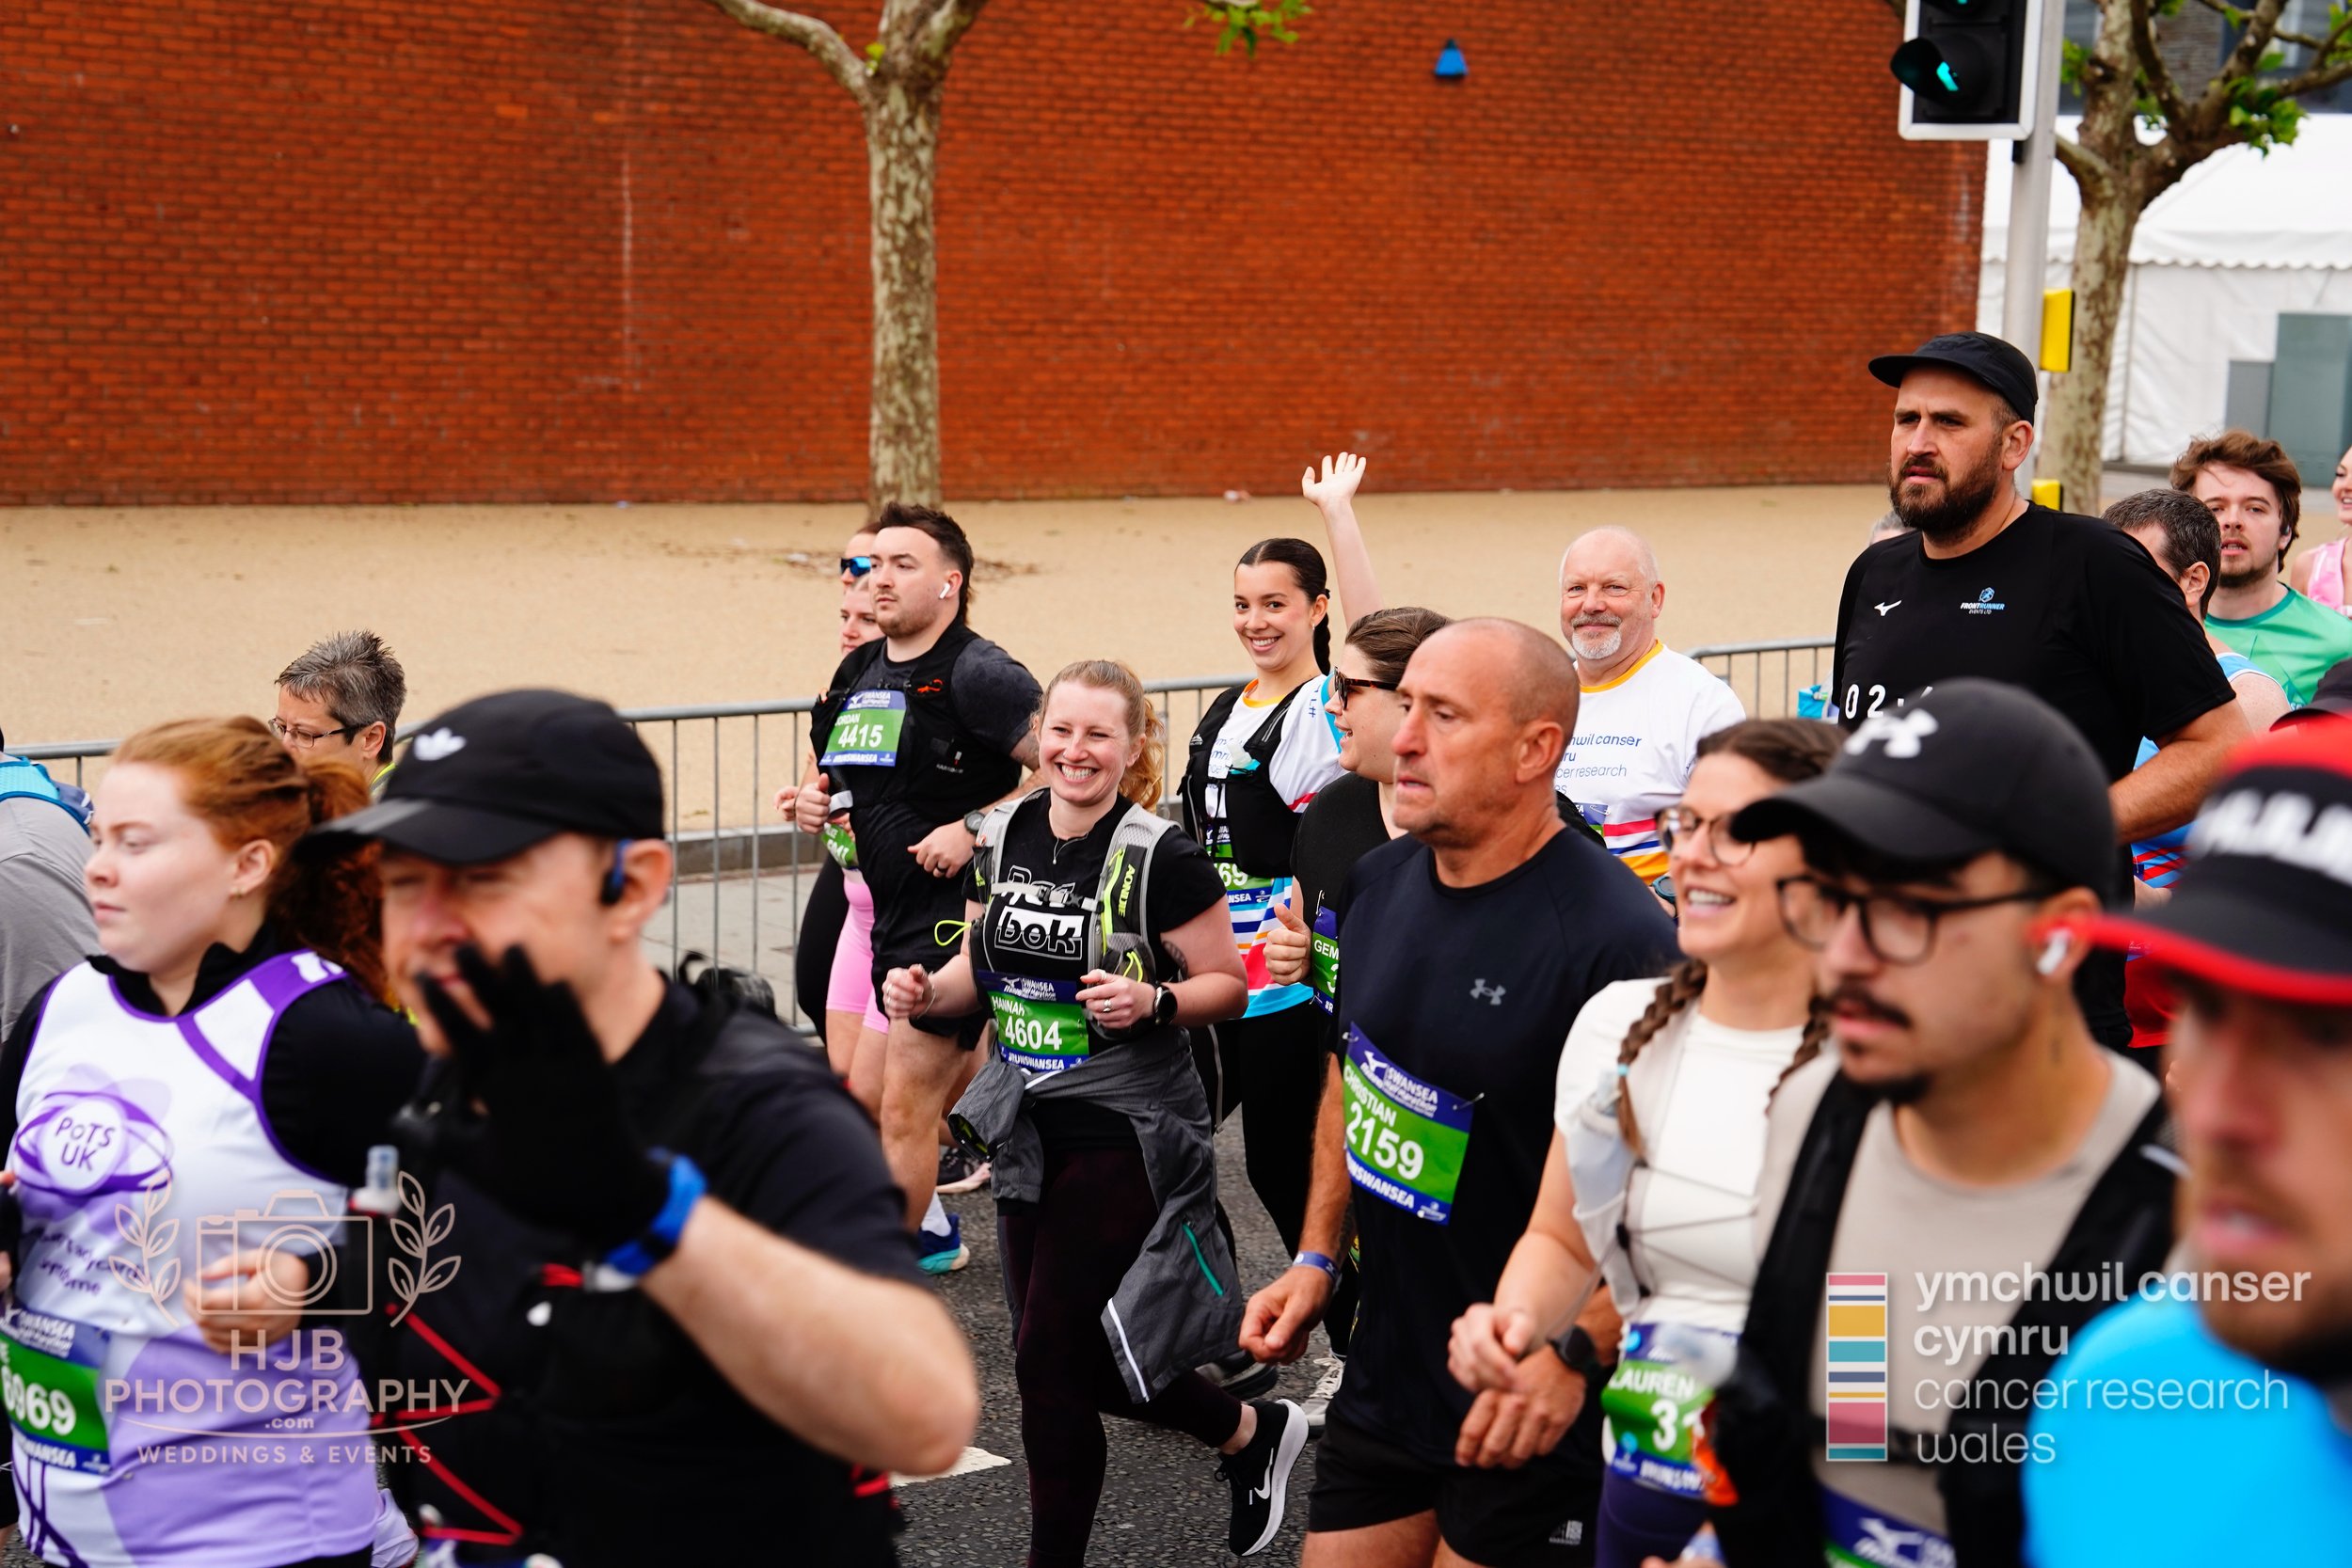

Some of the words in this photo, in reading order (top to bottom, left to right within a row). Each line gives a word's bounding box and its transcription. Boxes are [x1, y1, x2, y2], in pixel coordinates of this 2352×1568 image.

[837, 723, 884, 749] 4415
[1596, 735, 1642, 747] canser
[1575, 764, 1628, 778] research
[1313, 939, 1340, 960] GEM
[991, 995, 1025, 1017] HANNAH
[1005, 1015, 1063, 1051] 4604
[1343, 1065, 1397, 1128] CHRISTIAN
[1387, 1066, 1438, 1105] SWANSEA
[1345, 1100, 1424, 1180] 2159
[60, 1142, 96, 1172] UK
[1608, 1368, 1697, 1401] LAUREN
